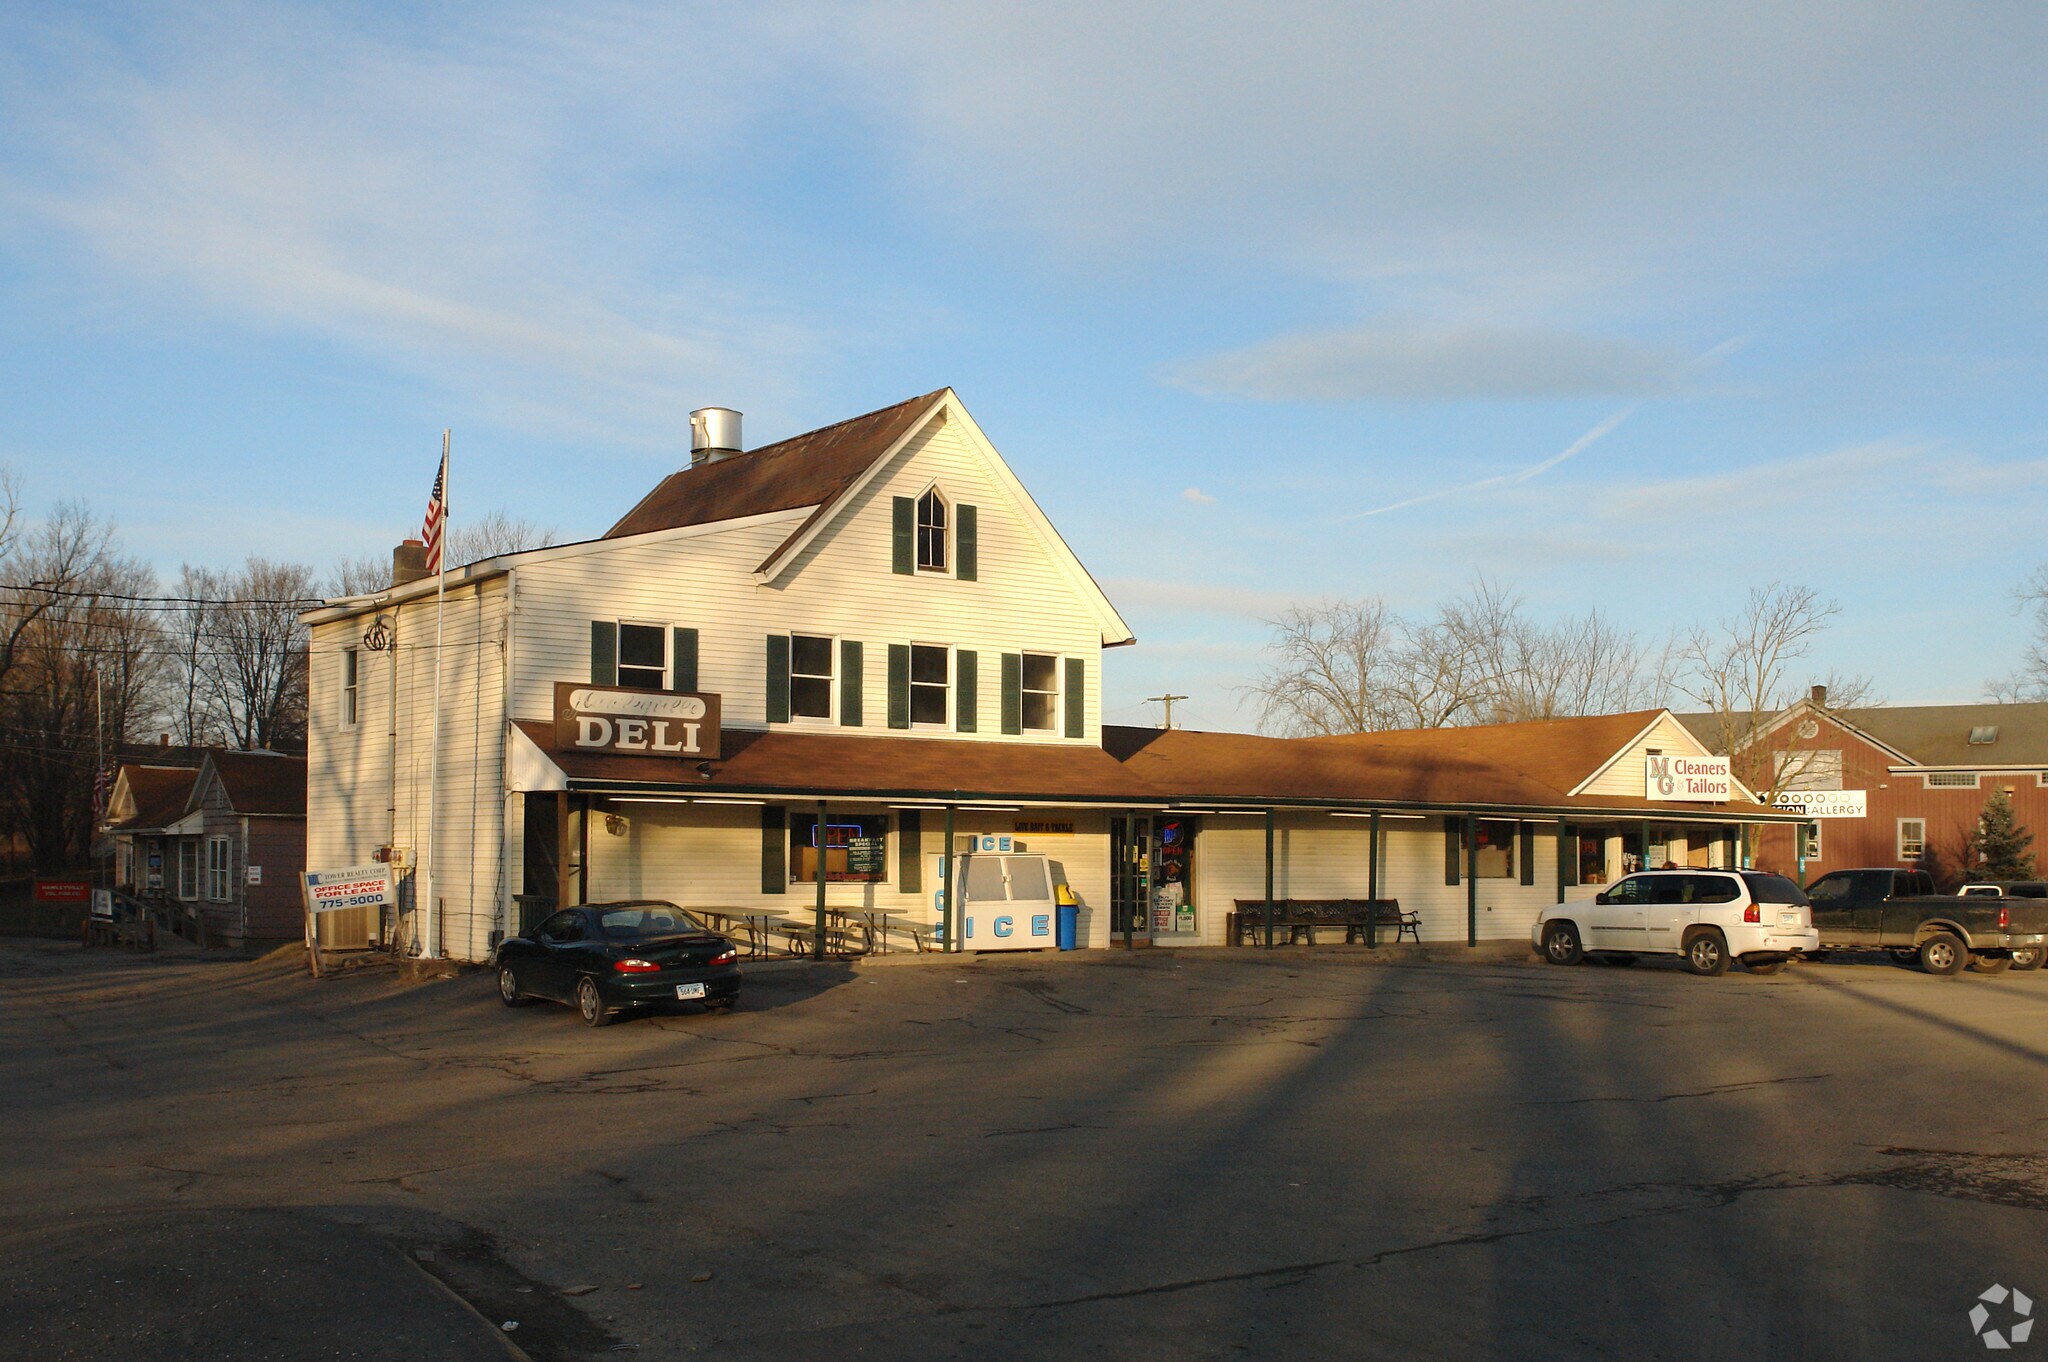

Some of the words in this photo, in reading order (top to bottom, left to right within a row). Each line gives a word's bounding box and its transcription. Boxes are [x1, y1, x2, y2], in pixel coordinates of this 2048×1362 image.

[575, 716, 701, 753] DELI
[1674, 759, 1726, 775] Cleaners
[1686, 778, 1727, 793] Tailors
[974, 836, 1012, 852] ICE
[314, 884, 351, 892] OFFICE
[352, 880, 385, 888] SPACE
[344, 886, 384, 895] LEASE
[320, 894, 383, 909] 775-5000
[966, 915, 1050, 938] ICE
